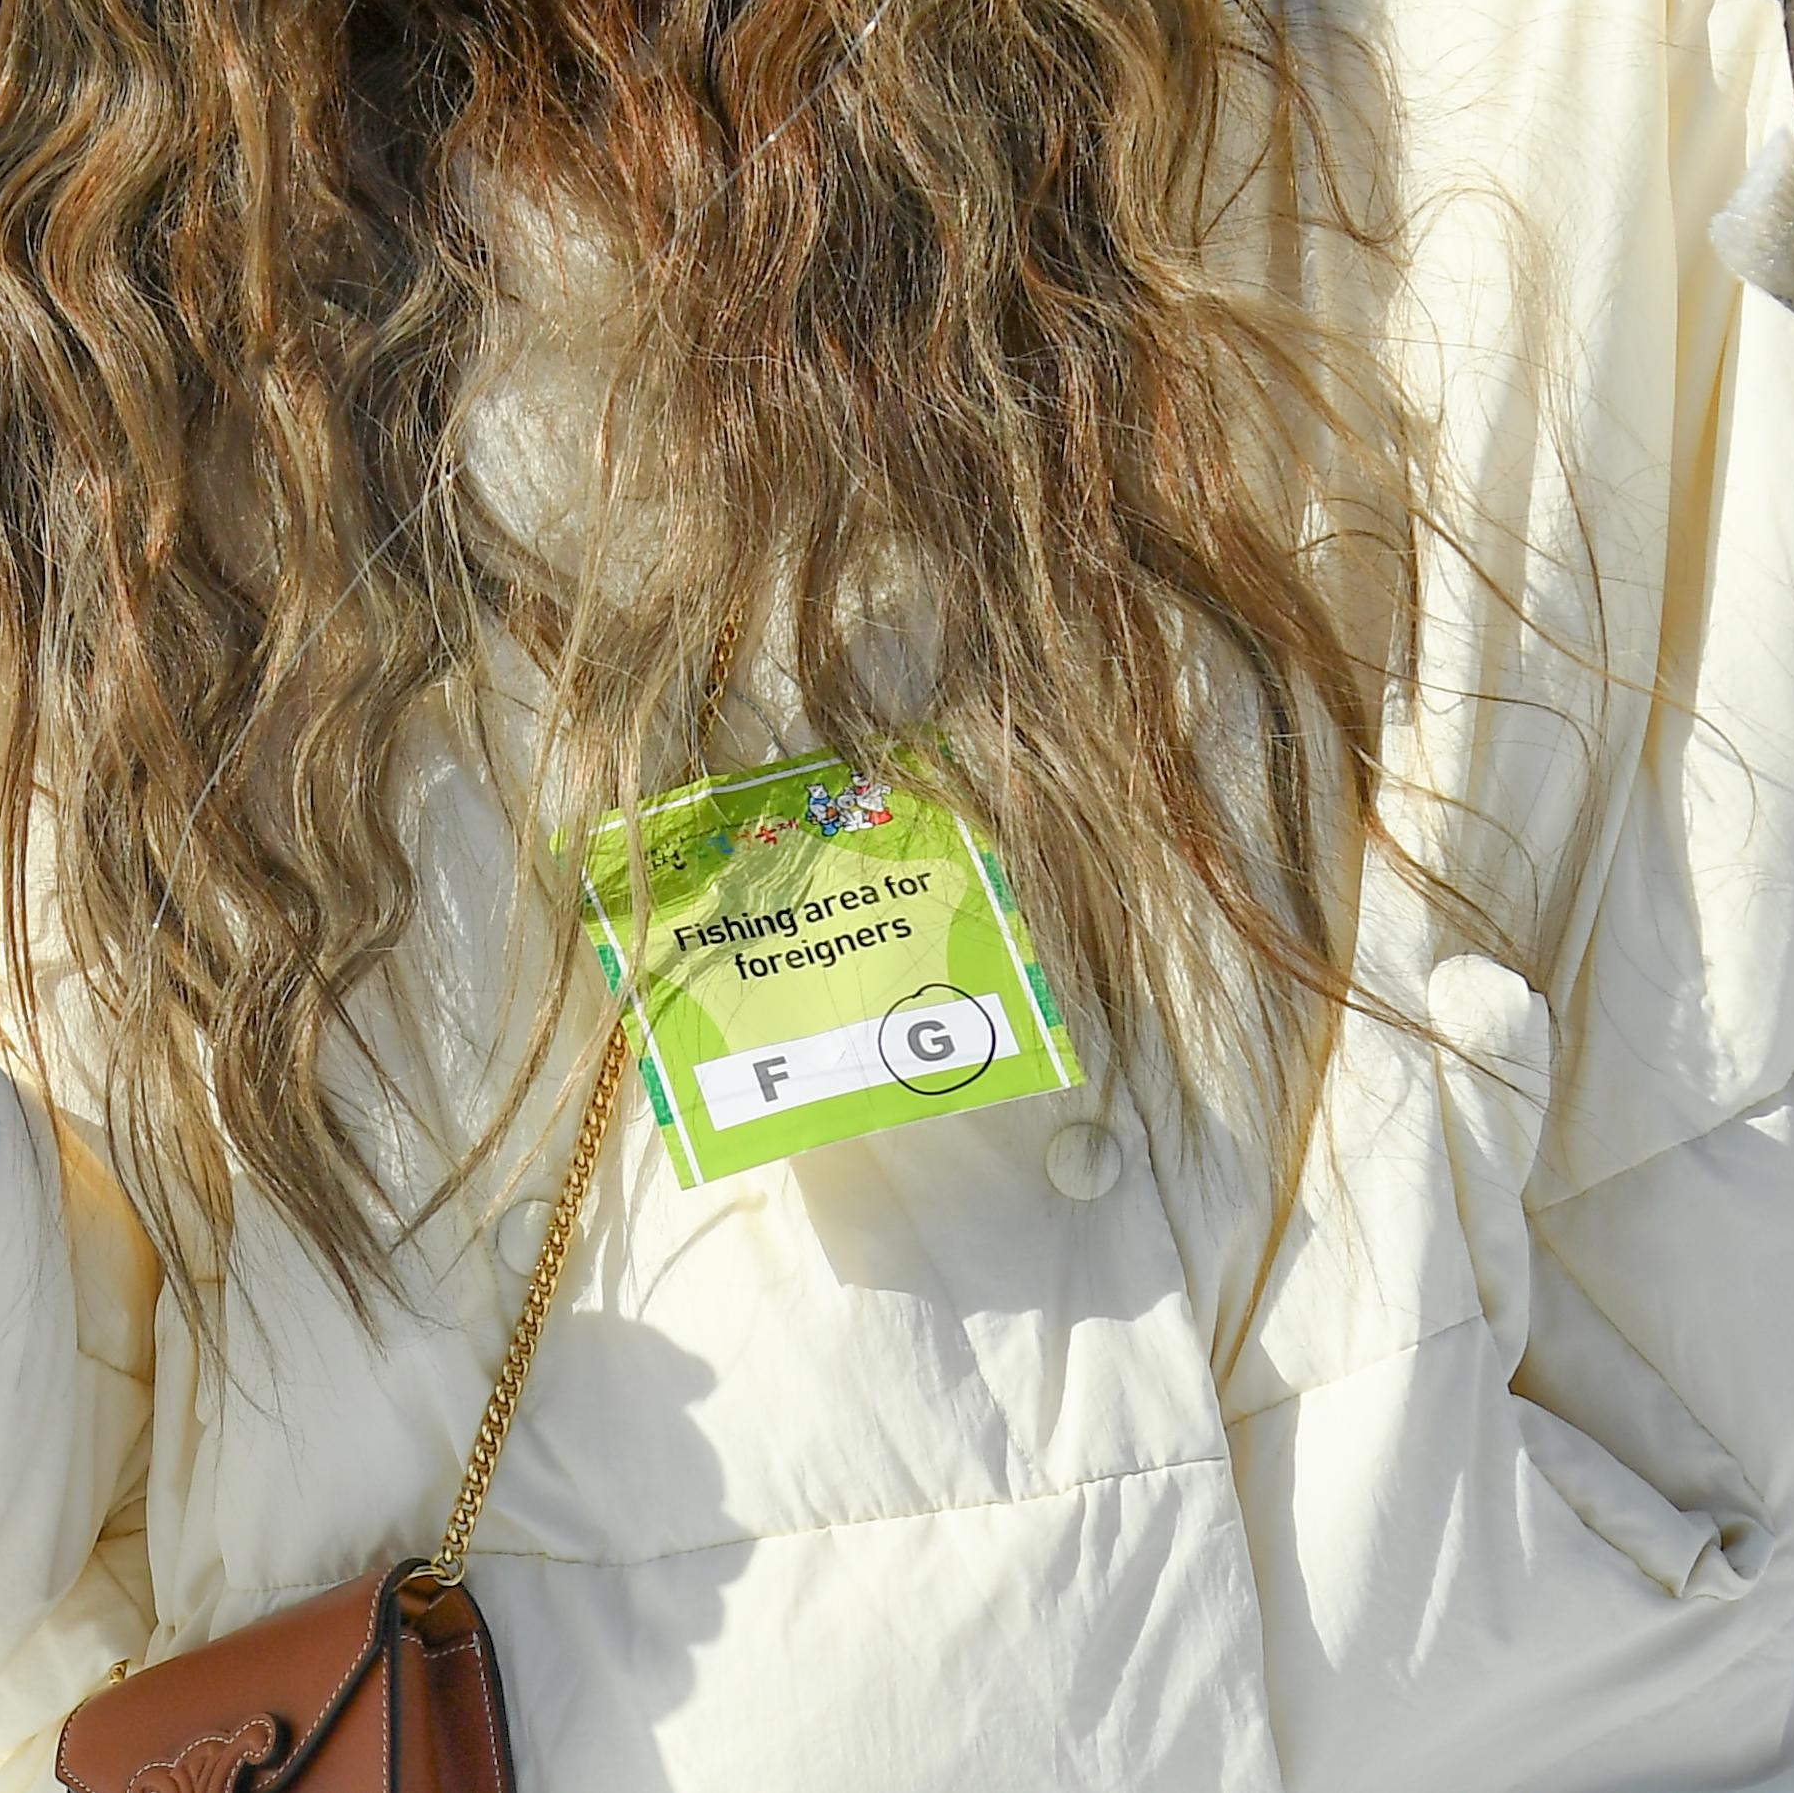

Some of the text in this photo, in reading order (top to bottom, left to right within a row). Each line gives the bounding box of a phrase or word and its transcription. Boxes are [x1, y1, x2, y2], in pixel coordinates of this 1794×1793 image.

[674, 871, 933, 951] Fishing area for
[735, 915, 912, 980] foreigners
[753, 1020, 955, 1102] F G
